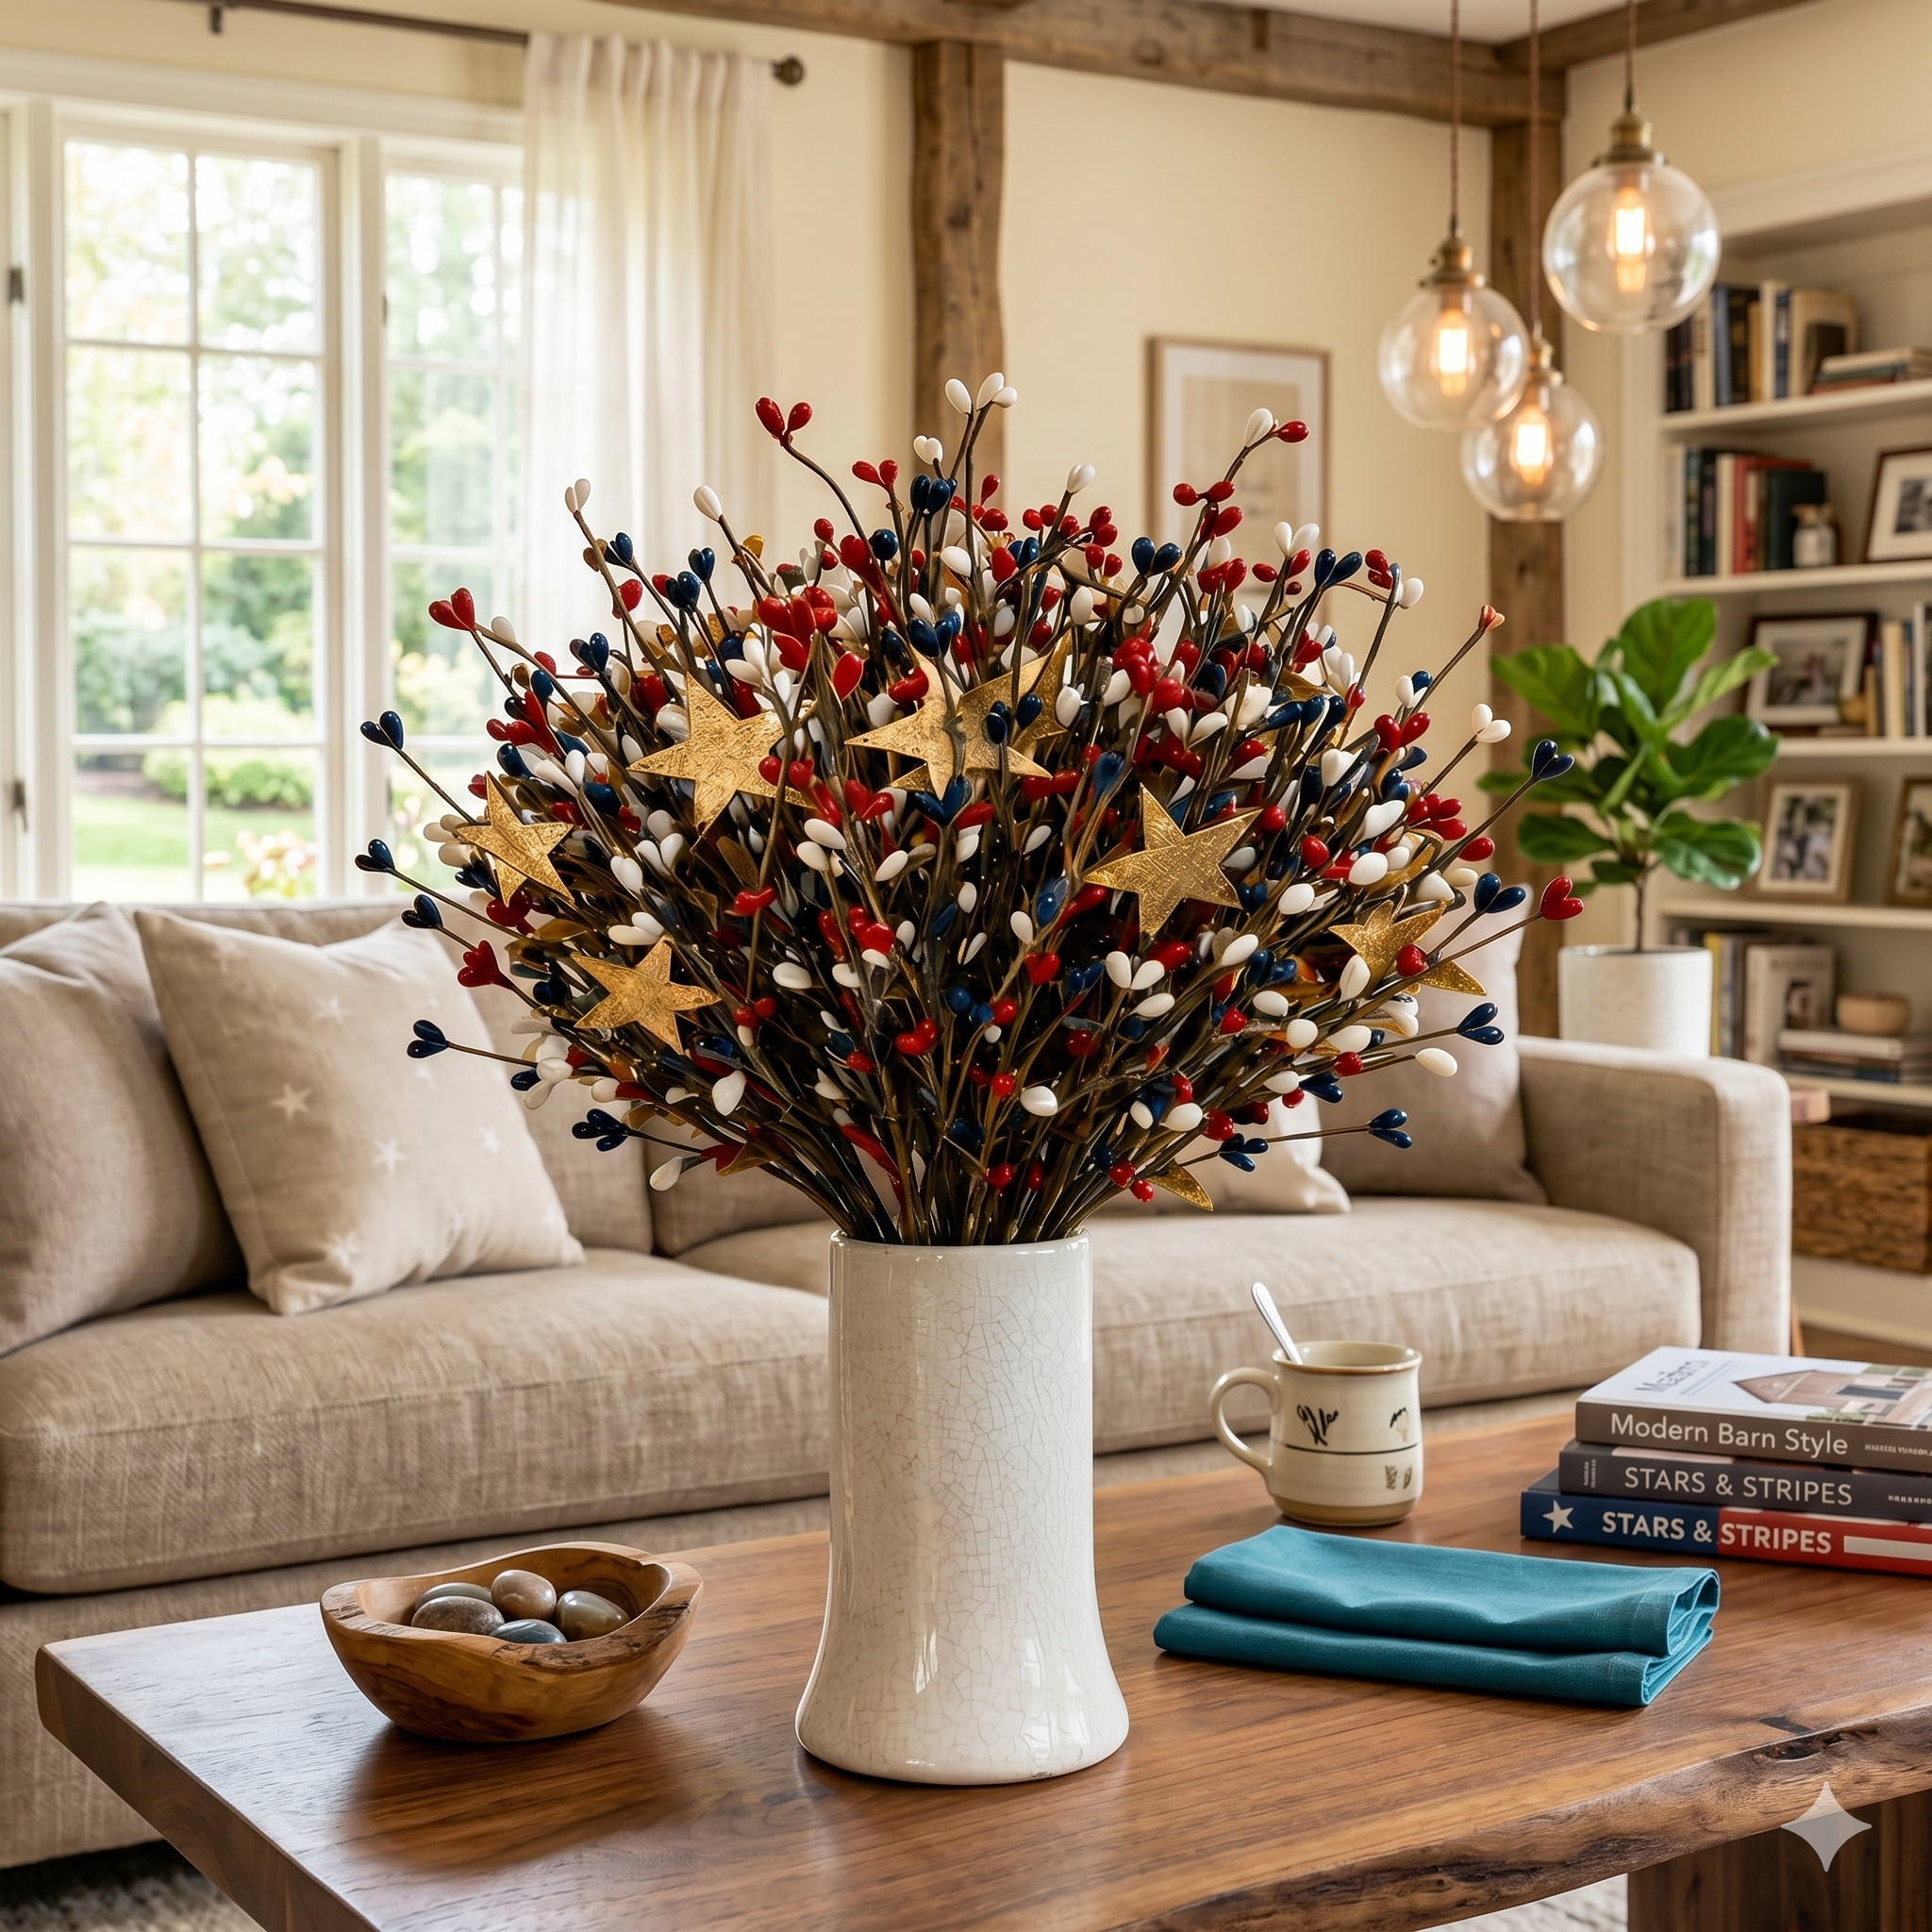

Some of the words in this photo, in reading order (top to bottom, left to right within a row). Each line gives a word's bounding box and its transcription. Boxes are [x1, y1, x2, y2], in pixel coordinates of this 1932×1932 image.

[1610, 1412, 1708, 1442] Modern
[1718, 1423, 1775, 1449] Barn
[1785, 1428, 1849, 1458] Style
[1624, 1467, 1706, 1493] STARS
[1715, 1474, 1734, 1496] &
[1743, 1475, 1852, 1506] STRIPES
[1602, 1511, 1685, 1540] STARS
[1693, 1520, 1712, 1542] &
[1721, 1523, 1831, 1554] STRIPES
